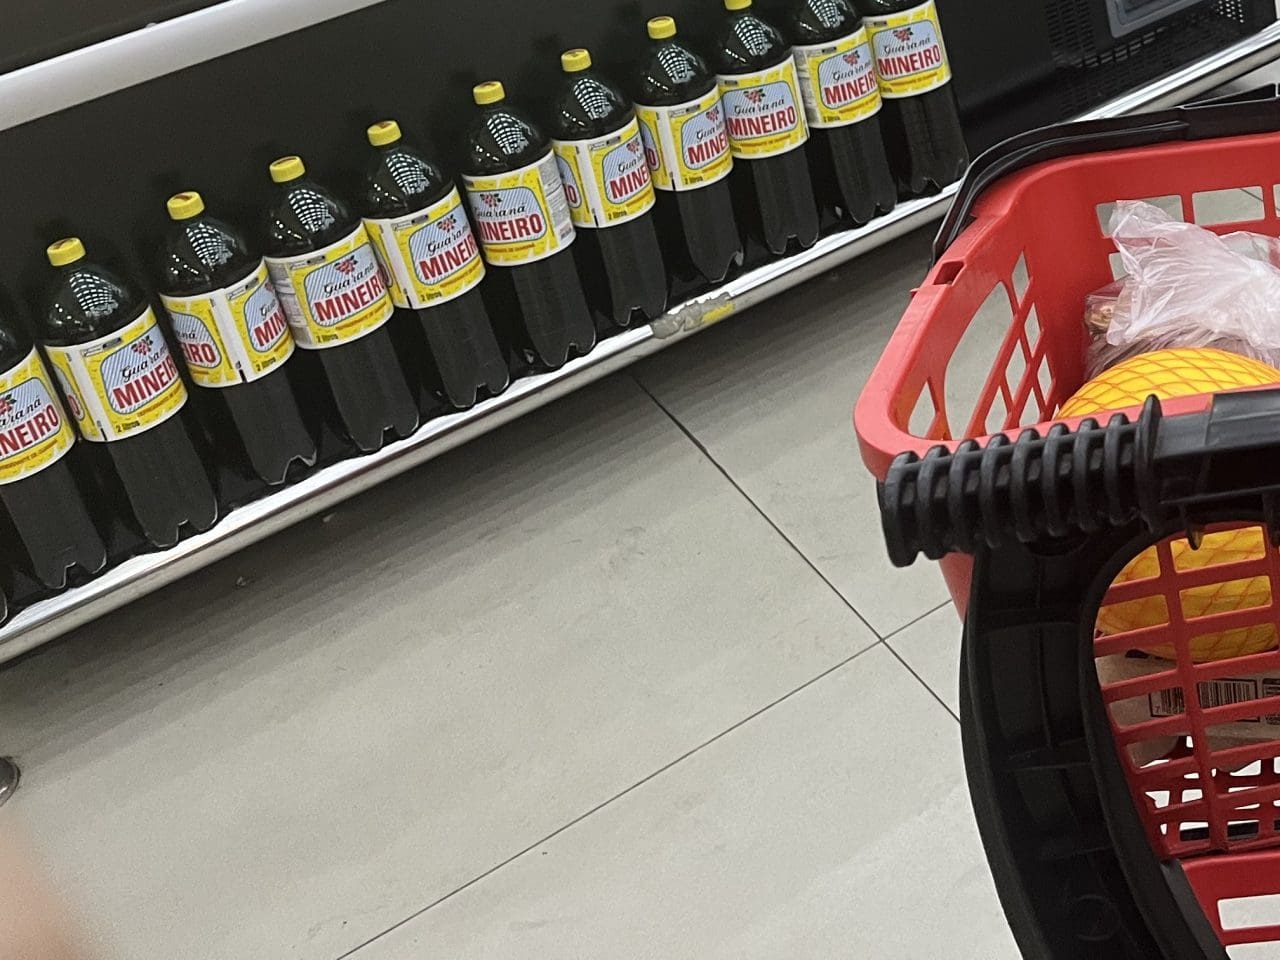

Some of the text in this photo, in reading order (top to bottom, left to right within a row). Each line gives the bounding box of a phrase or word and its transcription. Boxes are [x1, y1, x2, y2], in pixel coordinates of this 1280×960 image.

[878, 44, 941, 76] MINEIRO
[824, 70, 878, 104] MINEIR
[727, 105, 797, 136] MINEIRO
[419, 232, 477, 281] MINEIR
[112, 356, 177, 410] MINEIR
